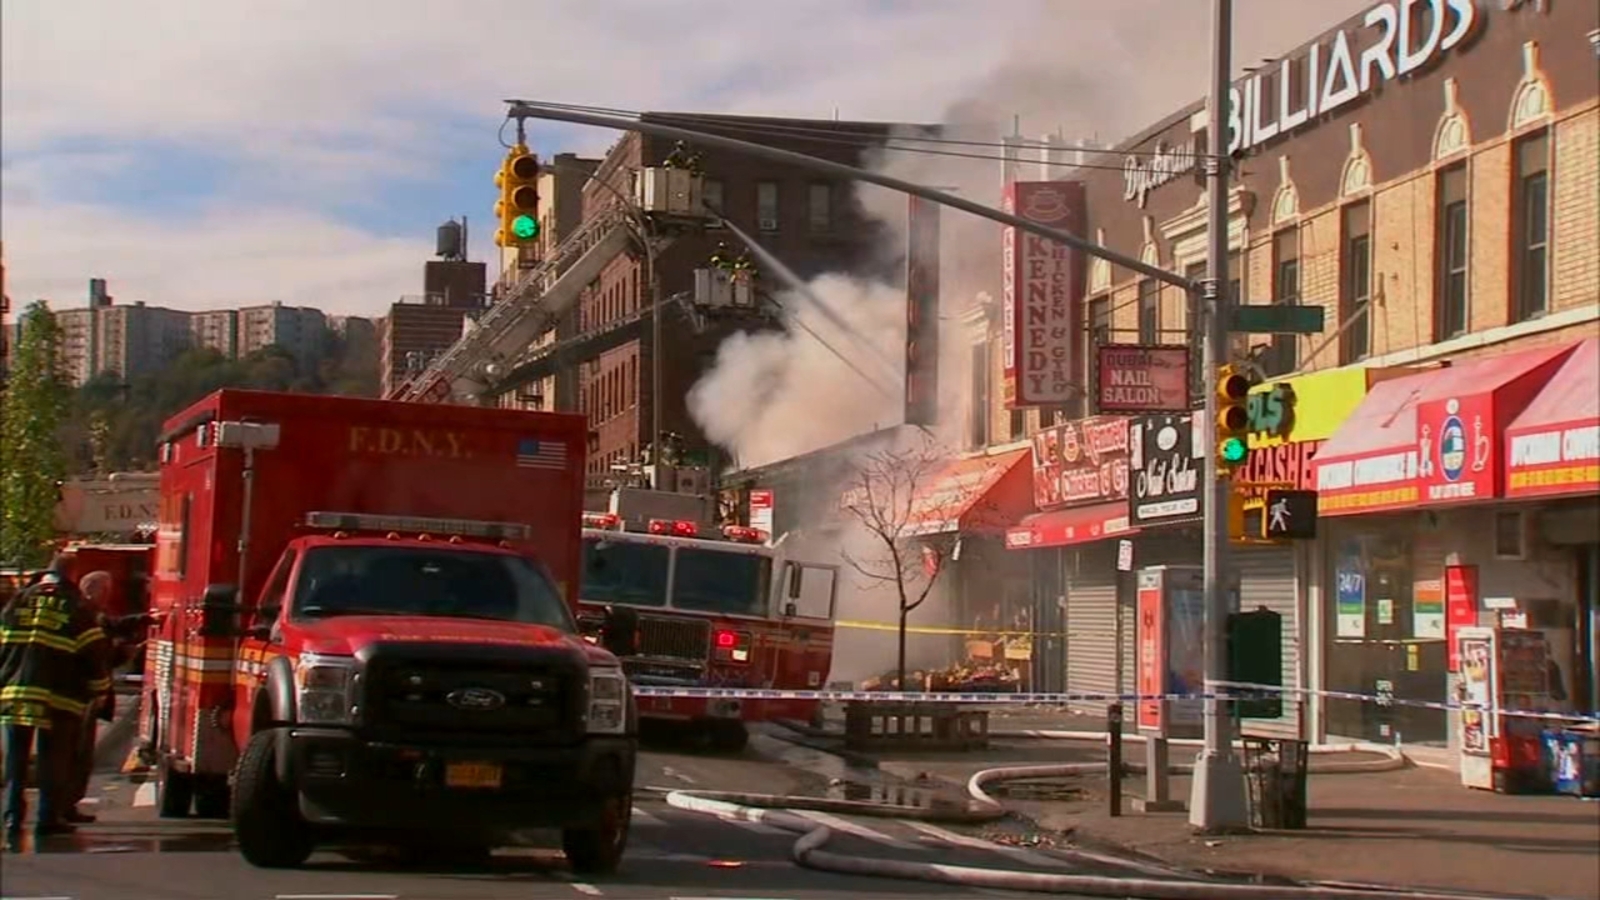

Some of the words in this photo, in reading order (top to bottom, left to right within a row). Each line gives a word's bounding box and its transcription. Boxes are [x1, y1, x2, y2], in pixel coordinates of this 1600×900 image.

[1228, 0, 1476, 155] BILLIARDS
[1027, 235, 1048, 395] KENNEDY
[1052, 346, 1066, 395] GYRO
[1103, 387, 1160, 403] SALON
[1110, 369, 1153, 386] NAIL
